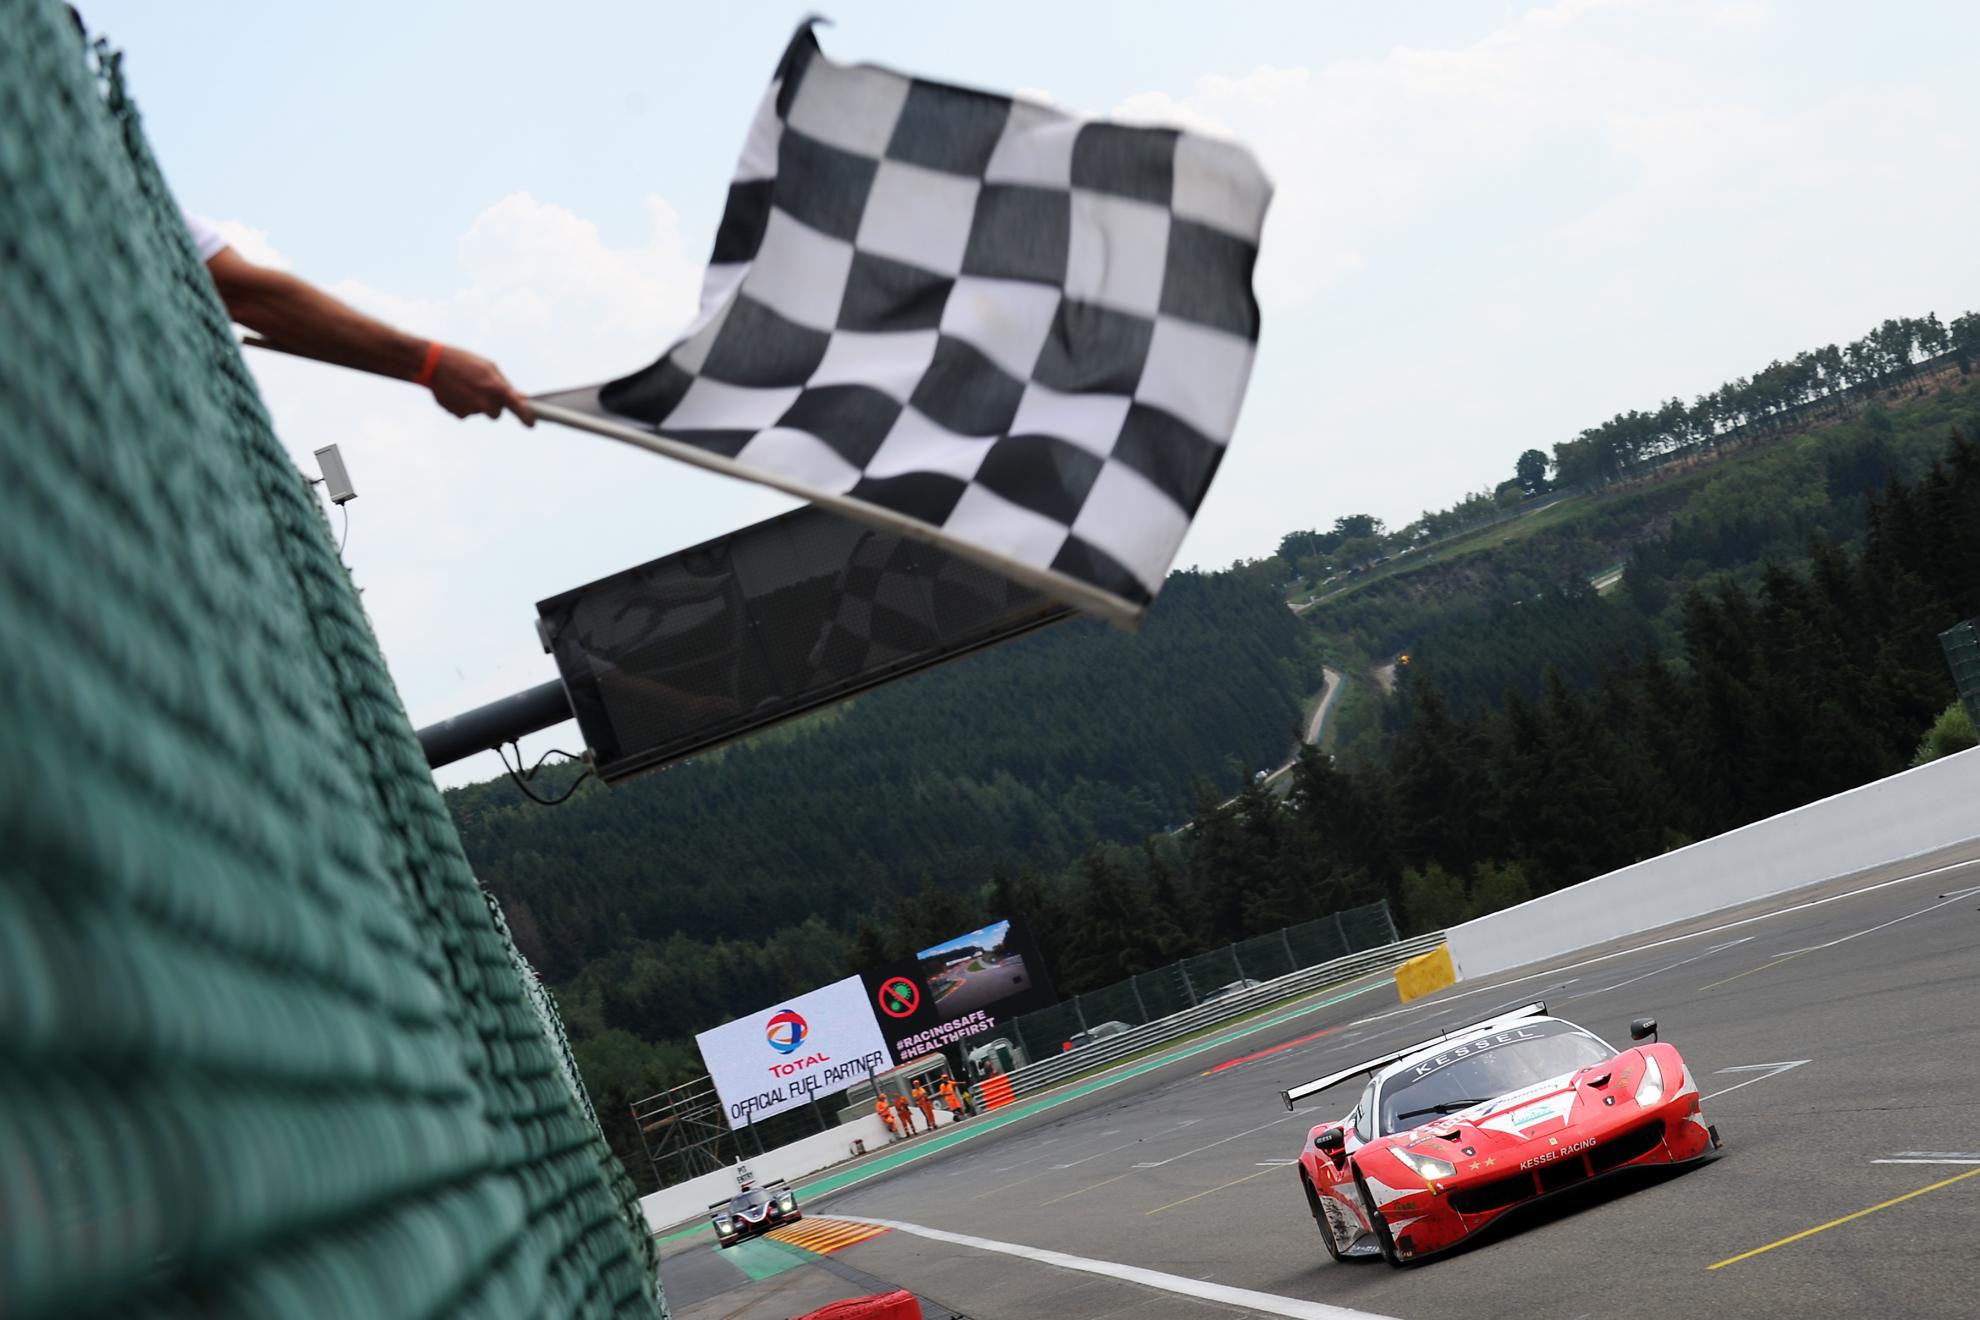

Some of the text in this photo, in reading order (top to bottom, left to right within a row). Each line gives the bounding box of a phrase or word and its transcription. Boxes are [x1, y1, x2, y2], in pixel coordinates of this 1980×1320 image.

[896, 1010, 986, 1050] #RACINGSAFE
[900, 1017, 995, 1060] #HEALTHFIRST
[768, 1052, 831, 1078] TOTAL
[1415, 1030, 1534, 1075] KESSEL
[731, 1050, 884, 1119] OFFICIAL FUEL PARTNER
[1520, 1137, 1597, 1171] KESSEL RACING
